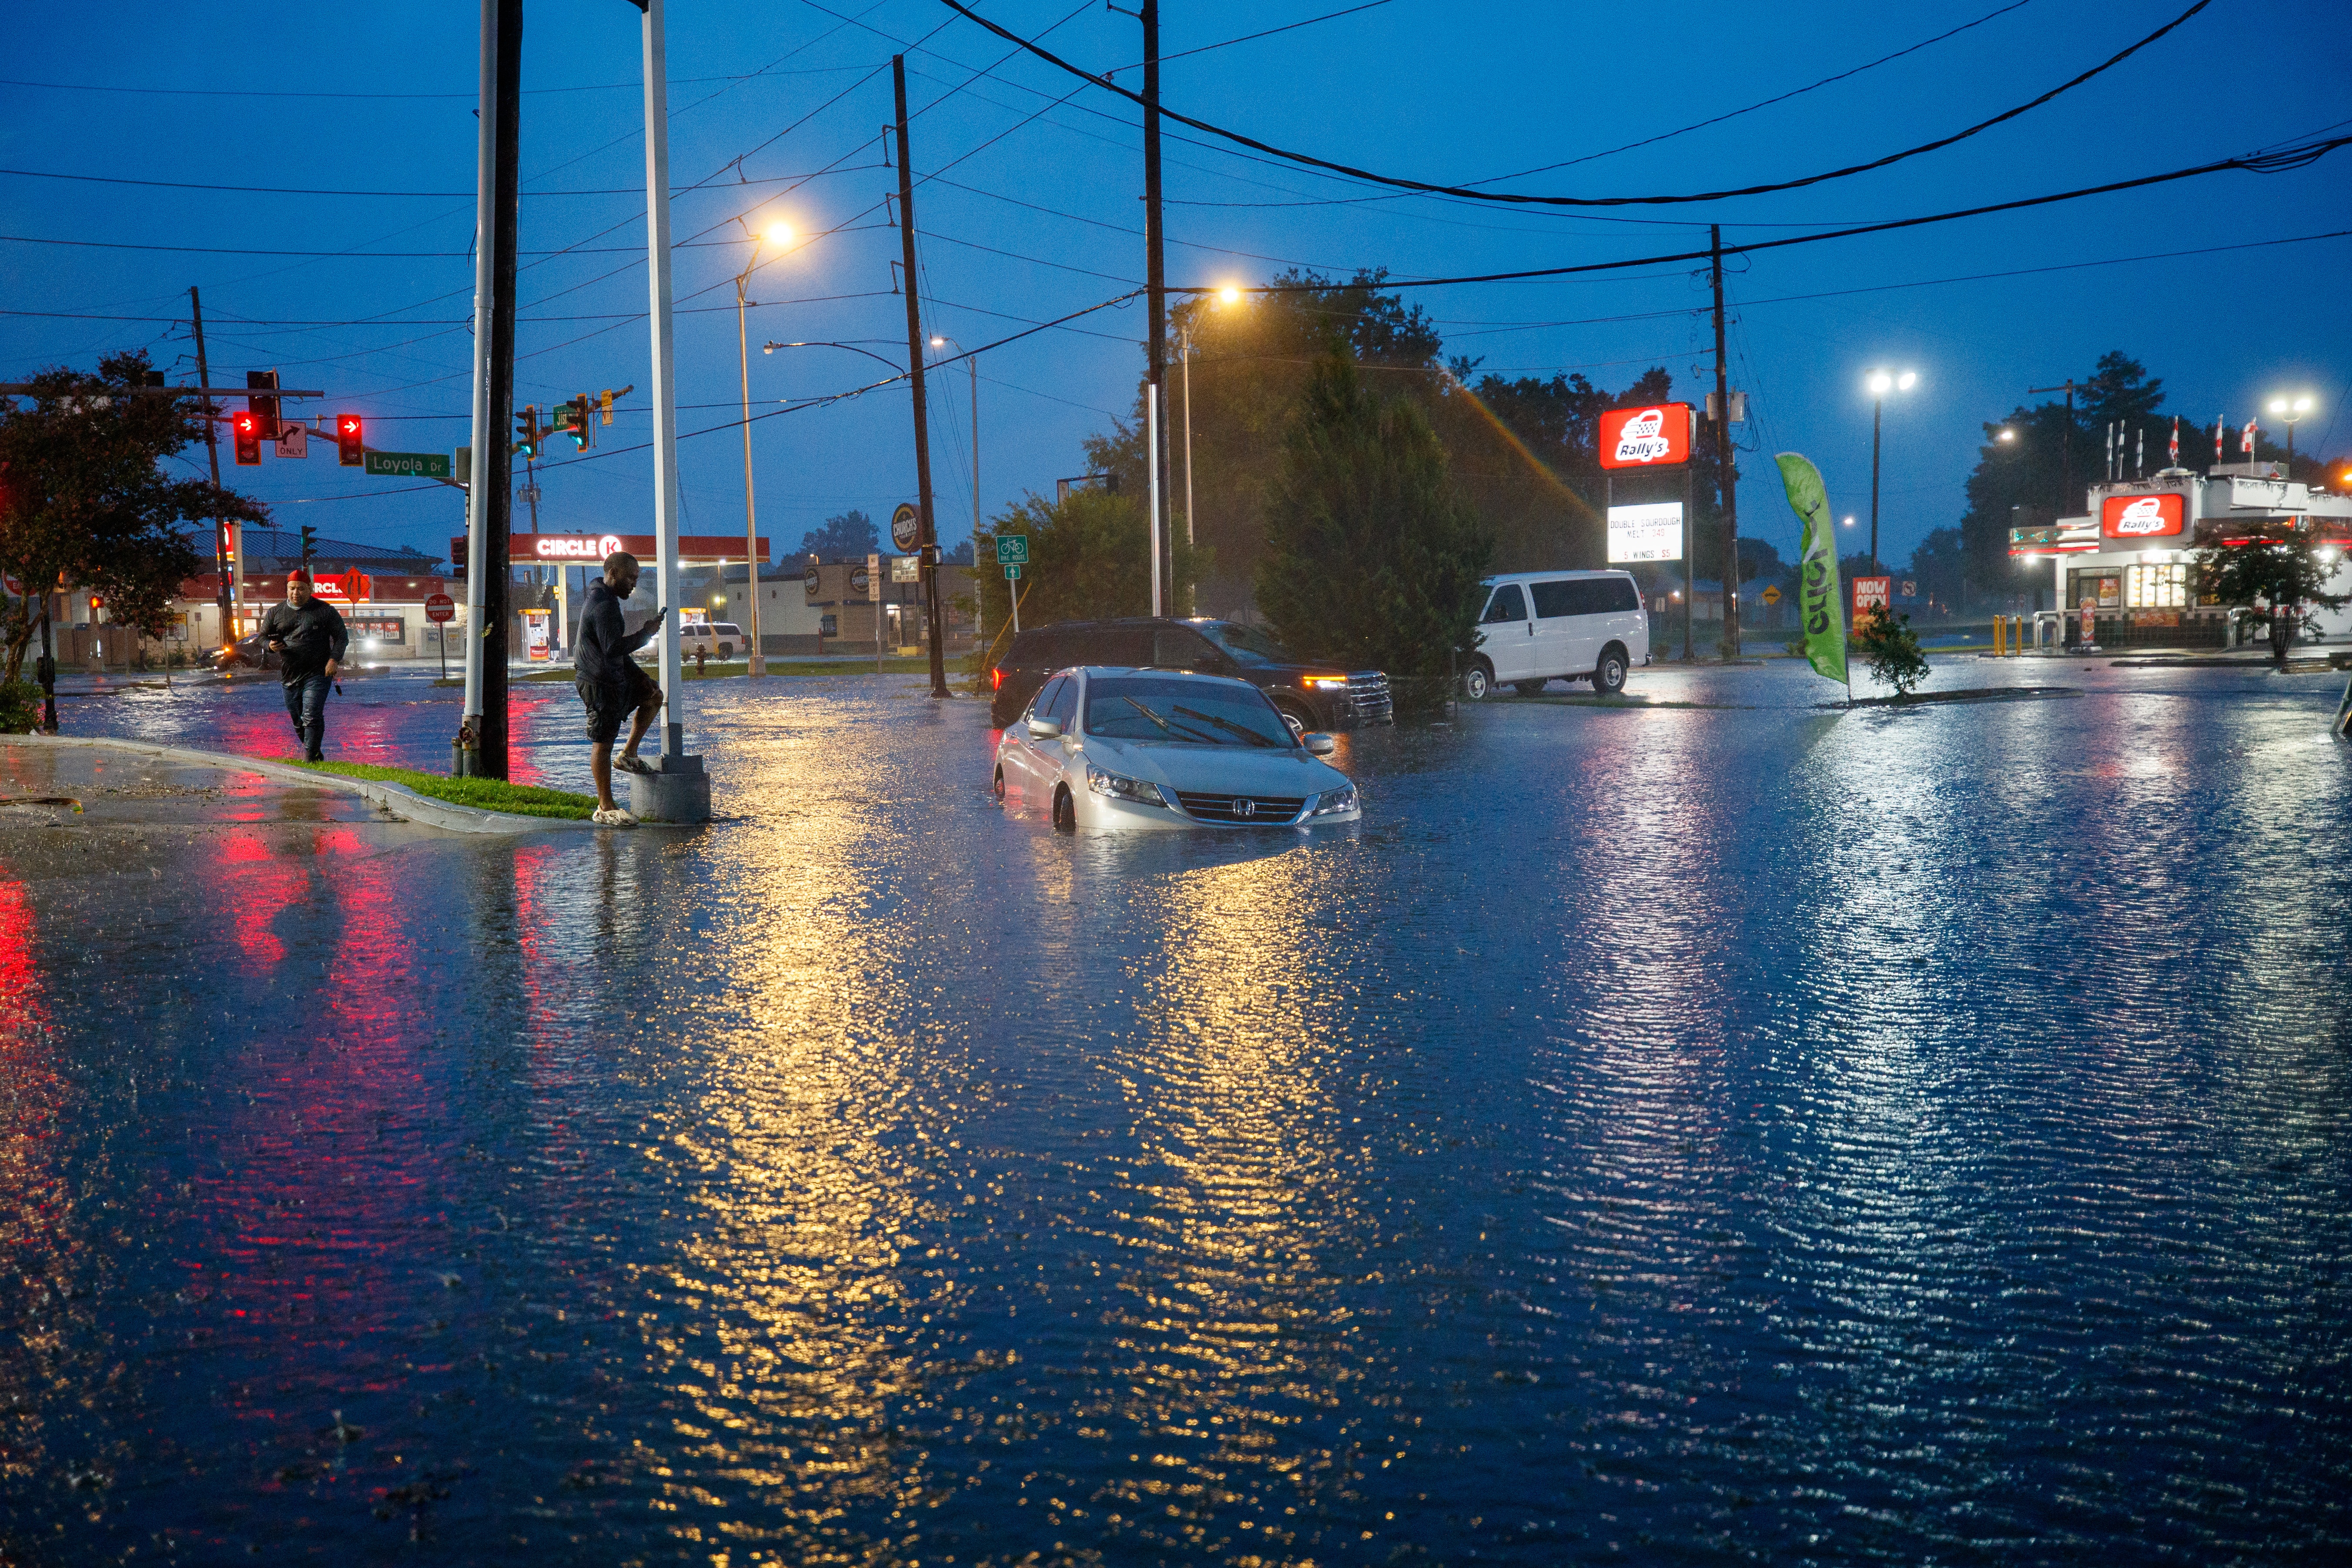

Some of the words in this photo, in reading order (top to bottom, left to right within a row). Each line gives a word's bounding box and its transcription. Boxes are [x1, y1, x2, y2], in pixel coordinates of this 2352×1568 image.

[1620, 441, 1663, 457] Rally's
[374, 456, 422, 473] Loyola
[430, 462, 442, 471] Dr
[893, 518, 917, 537] CHURCH'S
[1610, 520, 1636, 528] DOUBLE
[1641, 517, 1680, 527] SOURDOUGH
[2123, 521, 2161, 530] Rally's
[1627, 530, 1644, 538] MELT
[537, 539, 597, 556] CIRCLE
[1624, 552, 1628, 560] 5
[1633, 550, 1654, 559] WINGS
[1857, 581, 1887, 594] NOW
[1857, 594, 1887, 607] OPEN
